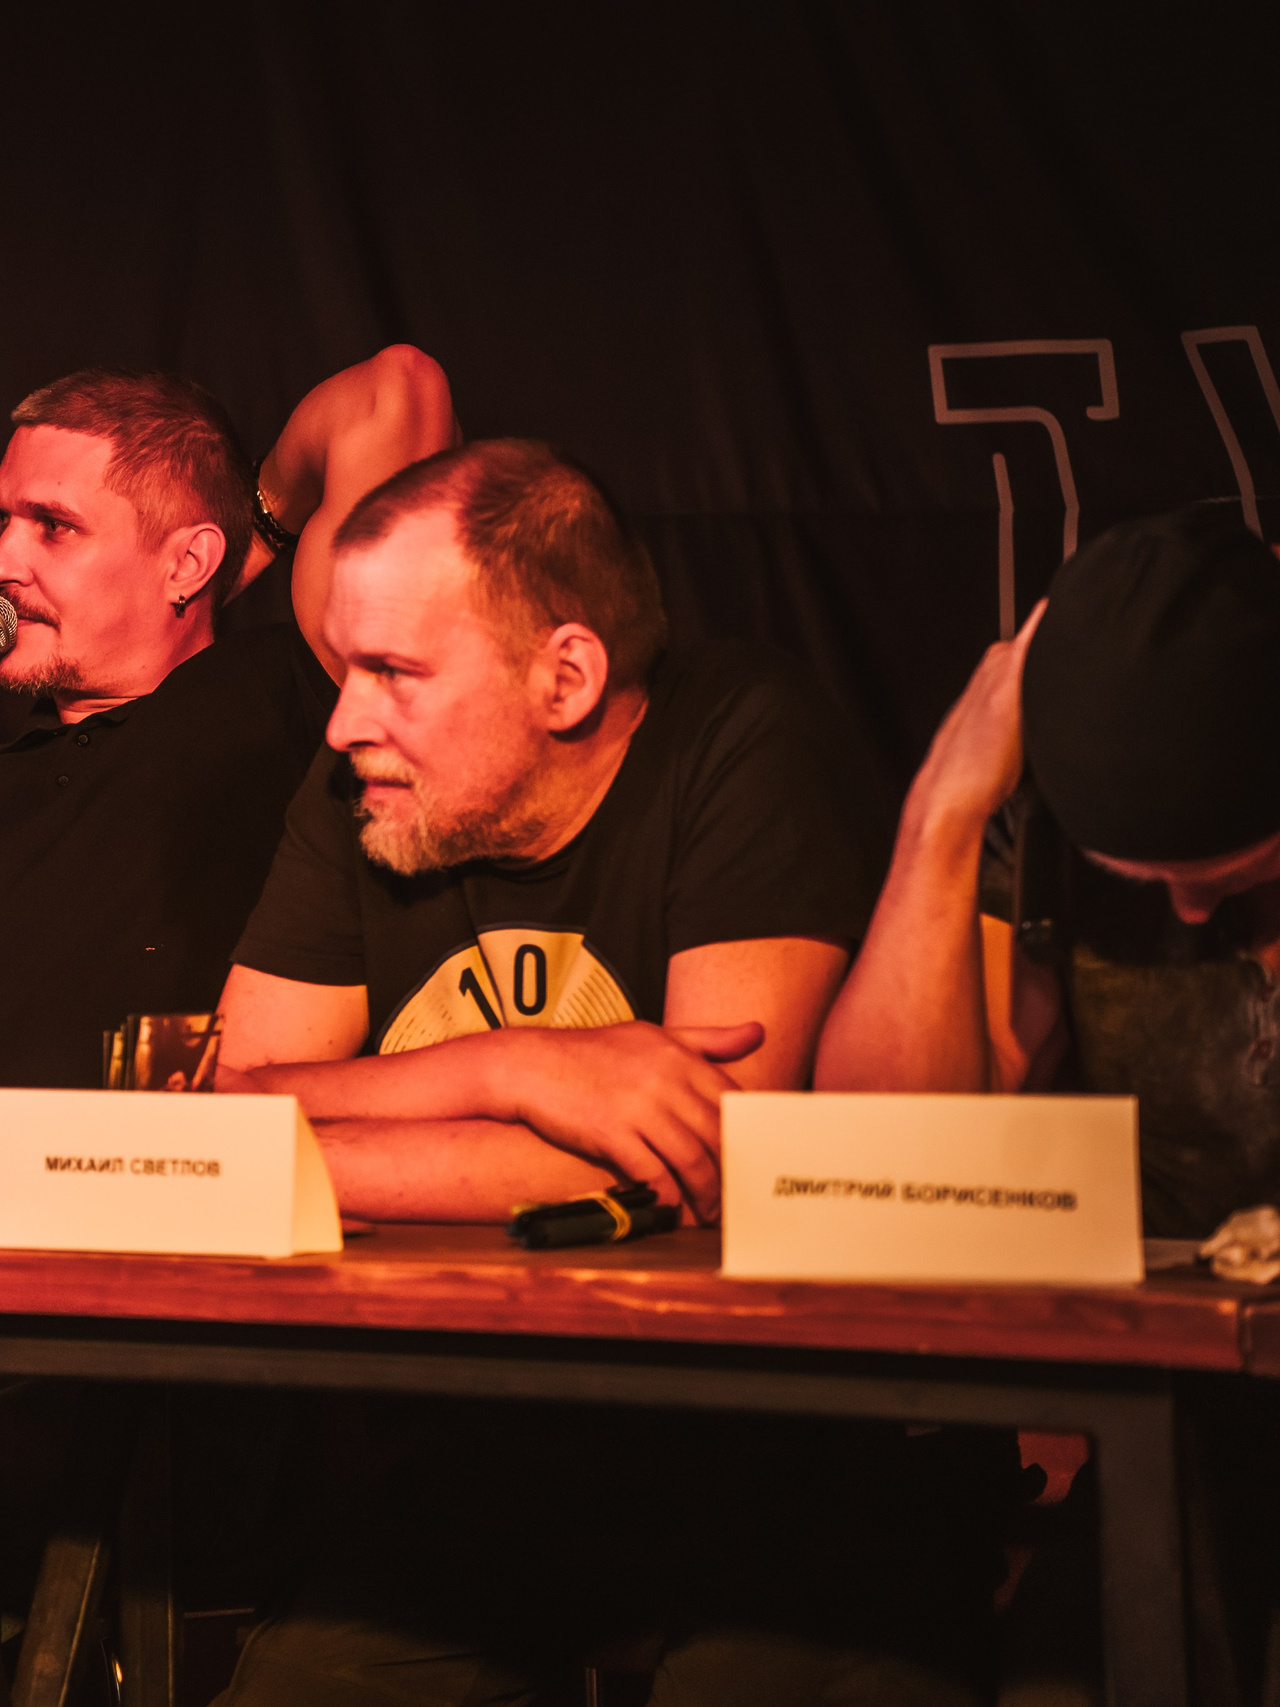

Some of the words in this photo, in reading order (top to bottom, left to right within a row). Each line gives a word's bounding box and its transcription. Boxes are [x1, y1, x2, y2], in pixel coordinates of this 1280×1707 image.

[45, 1156, 123, 1174] МИХАИЛ
[130, 1157, 220, 1178] СВЕТЛОВ
[774, 1176, 896, 1200] ДМИТРИЙ
